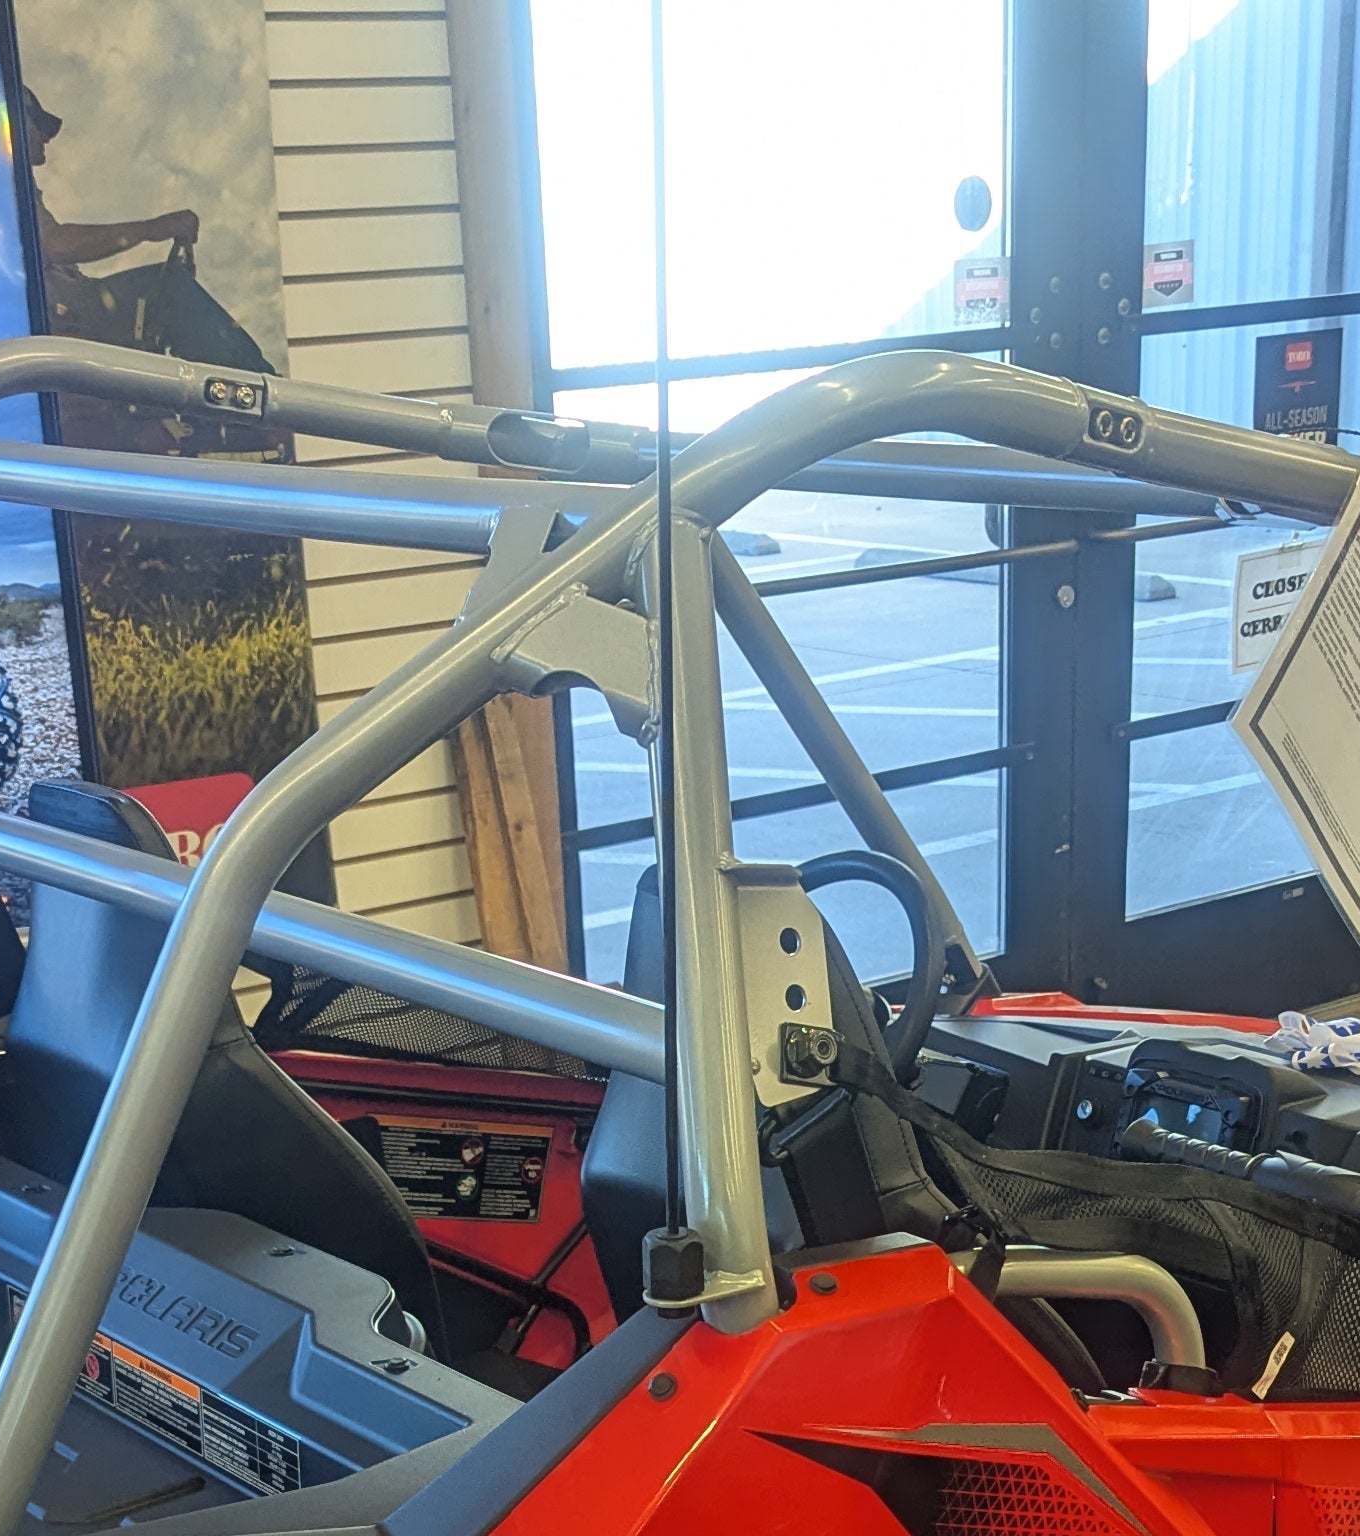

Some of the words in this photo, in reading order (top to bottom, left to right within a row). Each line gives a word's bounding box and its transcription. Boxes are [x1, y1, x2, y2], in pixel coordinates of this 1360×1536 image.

[1265, 405, 1328, 430] ALL-SEASON
[1252, 573, 1308, 600] CLOSE
[1240, 614, 1285, 637] CERR
